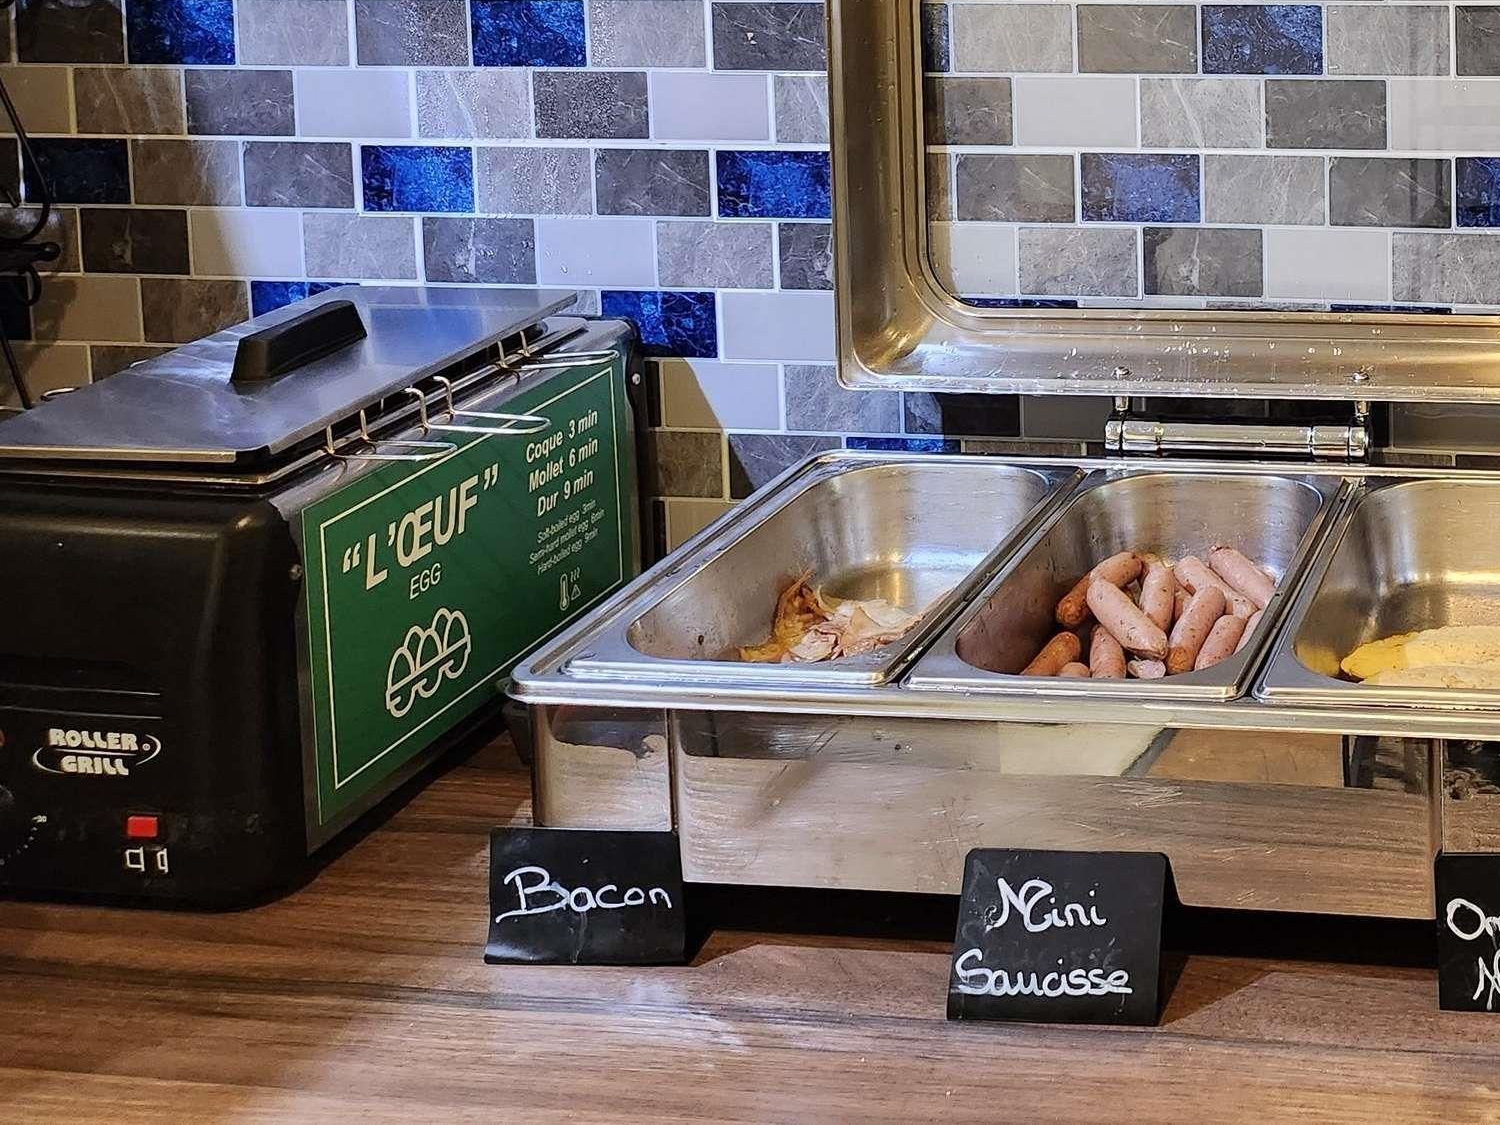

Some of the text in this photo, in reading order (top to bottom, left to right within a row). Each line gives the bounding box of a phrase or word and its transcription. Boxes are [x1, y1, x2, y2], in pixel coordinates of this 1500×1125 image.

[526, 409, 598, 463] Coque 3 min
[529, 437, 598, 493] Mollet 6 min
[537, 469, 593, 517] Dur 9 min
[569, 510, 580, 523] egg
[578, 520, 589, 532] egg
[571, 539, 582, 552] egg
[409, 563, 441, 600] EGG
[49, 728, 138, 752] ROLLER
[60, 756, 129, 776] GRILL
[495, 864, 672, 924] Bacon
[984, 877, 1107, 934] Mini
[954, 949, 1133, 999] Saucisse
